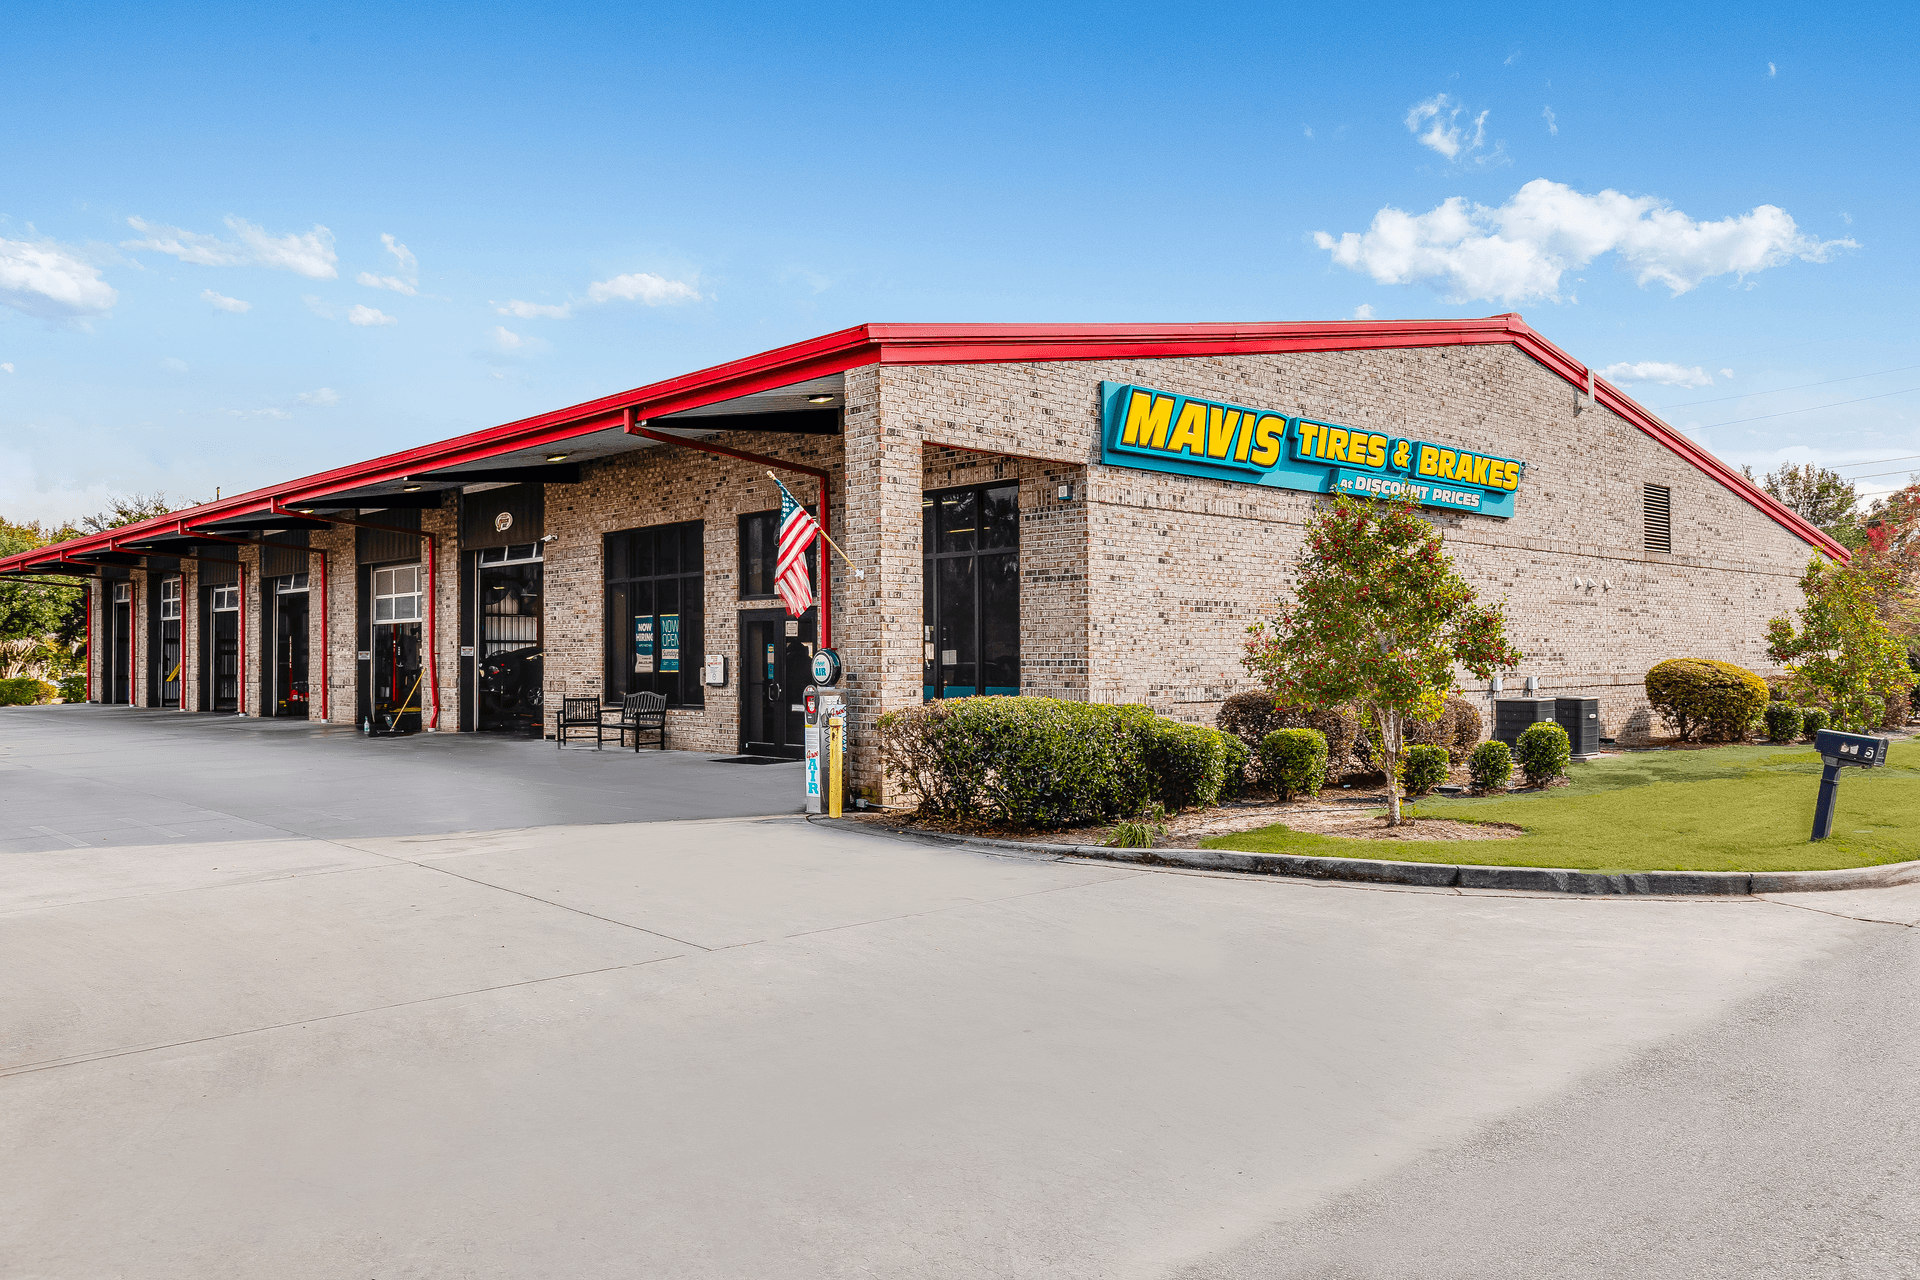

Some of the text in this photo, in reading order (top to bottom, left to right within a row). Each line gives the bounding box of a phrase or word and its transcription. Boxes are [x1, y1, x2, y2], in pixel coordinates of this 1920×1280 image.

[1121, 390, 1521, 491] MAVIS TIRES & BRAKES
[1354, 476, 1430, 500] DISCOUNT
[1432, 487, 1481, 507] PRICES
[638, 623, 652, 632] NOW
[662, 620, 679, 632] NOW
[662, 634, 679, 646] OPEN
[815, 667, 827, 677] AIR
[807, 758, 819, 794] AIR
